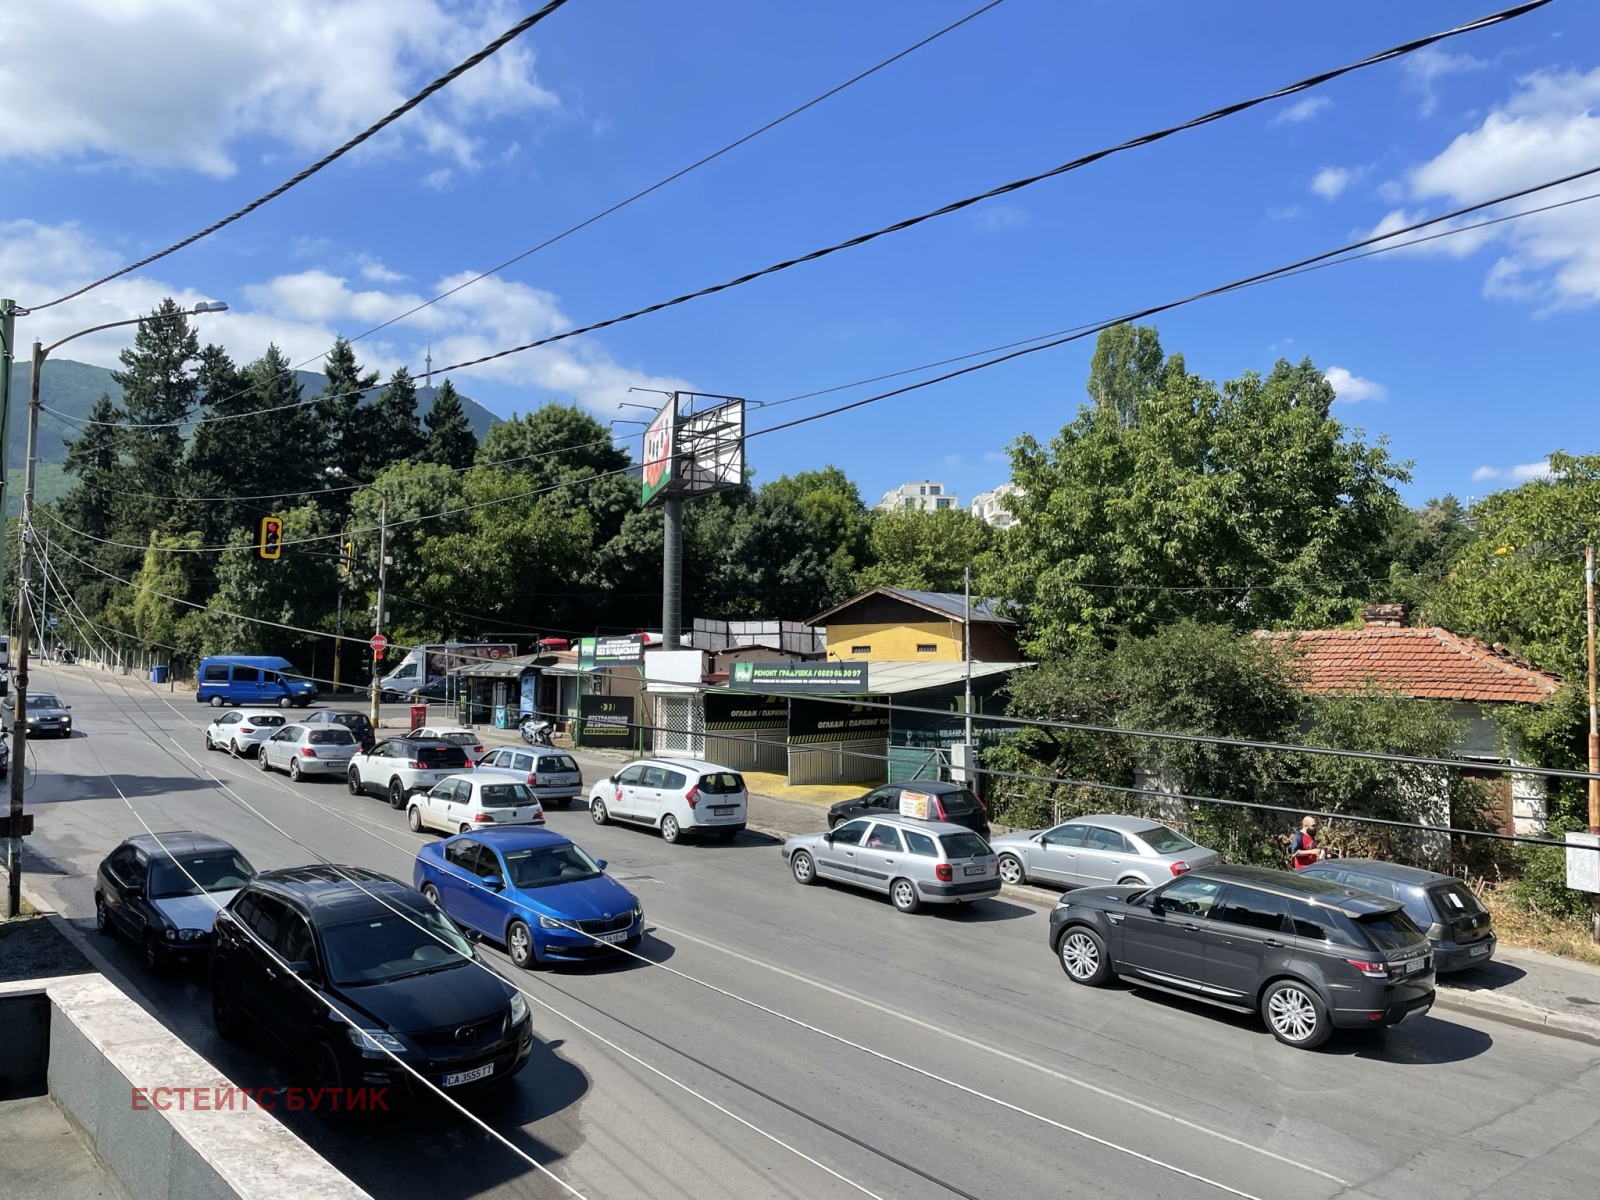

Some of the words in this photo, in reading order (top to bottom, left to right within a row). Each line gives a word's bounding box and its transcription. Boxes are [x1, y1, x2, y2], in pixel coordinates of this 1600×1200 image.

[778, 669, 813, 677] ГРАДУШКА
[817, 720, 844, 728] ОГЛЕДИ
[448, 1076, 460, 1085] CA
[461, 1069, 481, 1083] 3555
[482, 1065, 493, 1075] TT
